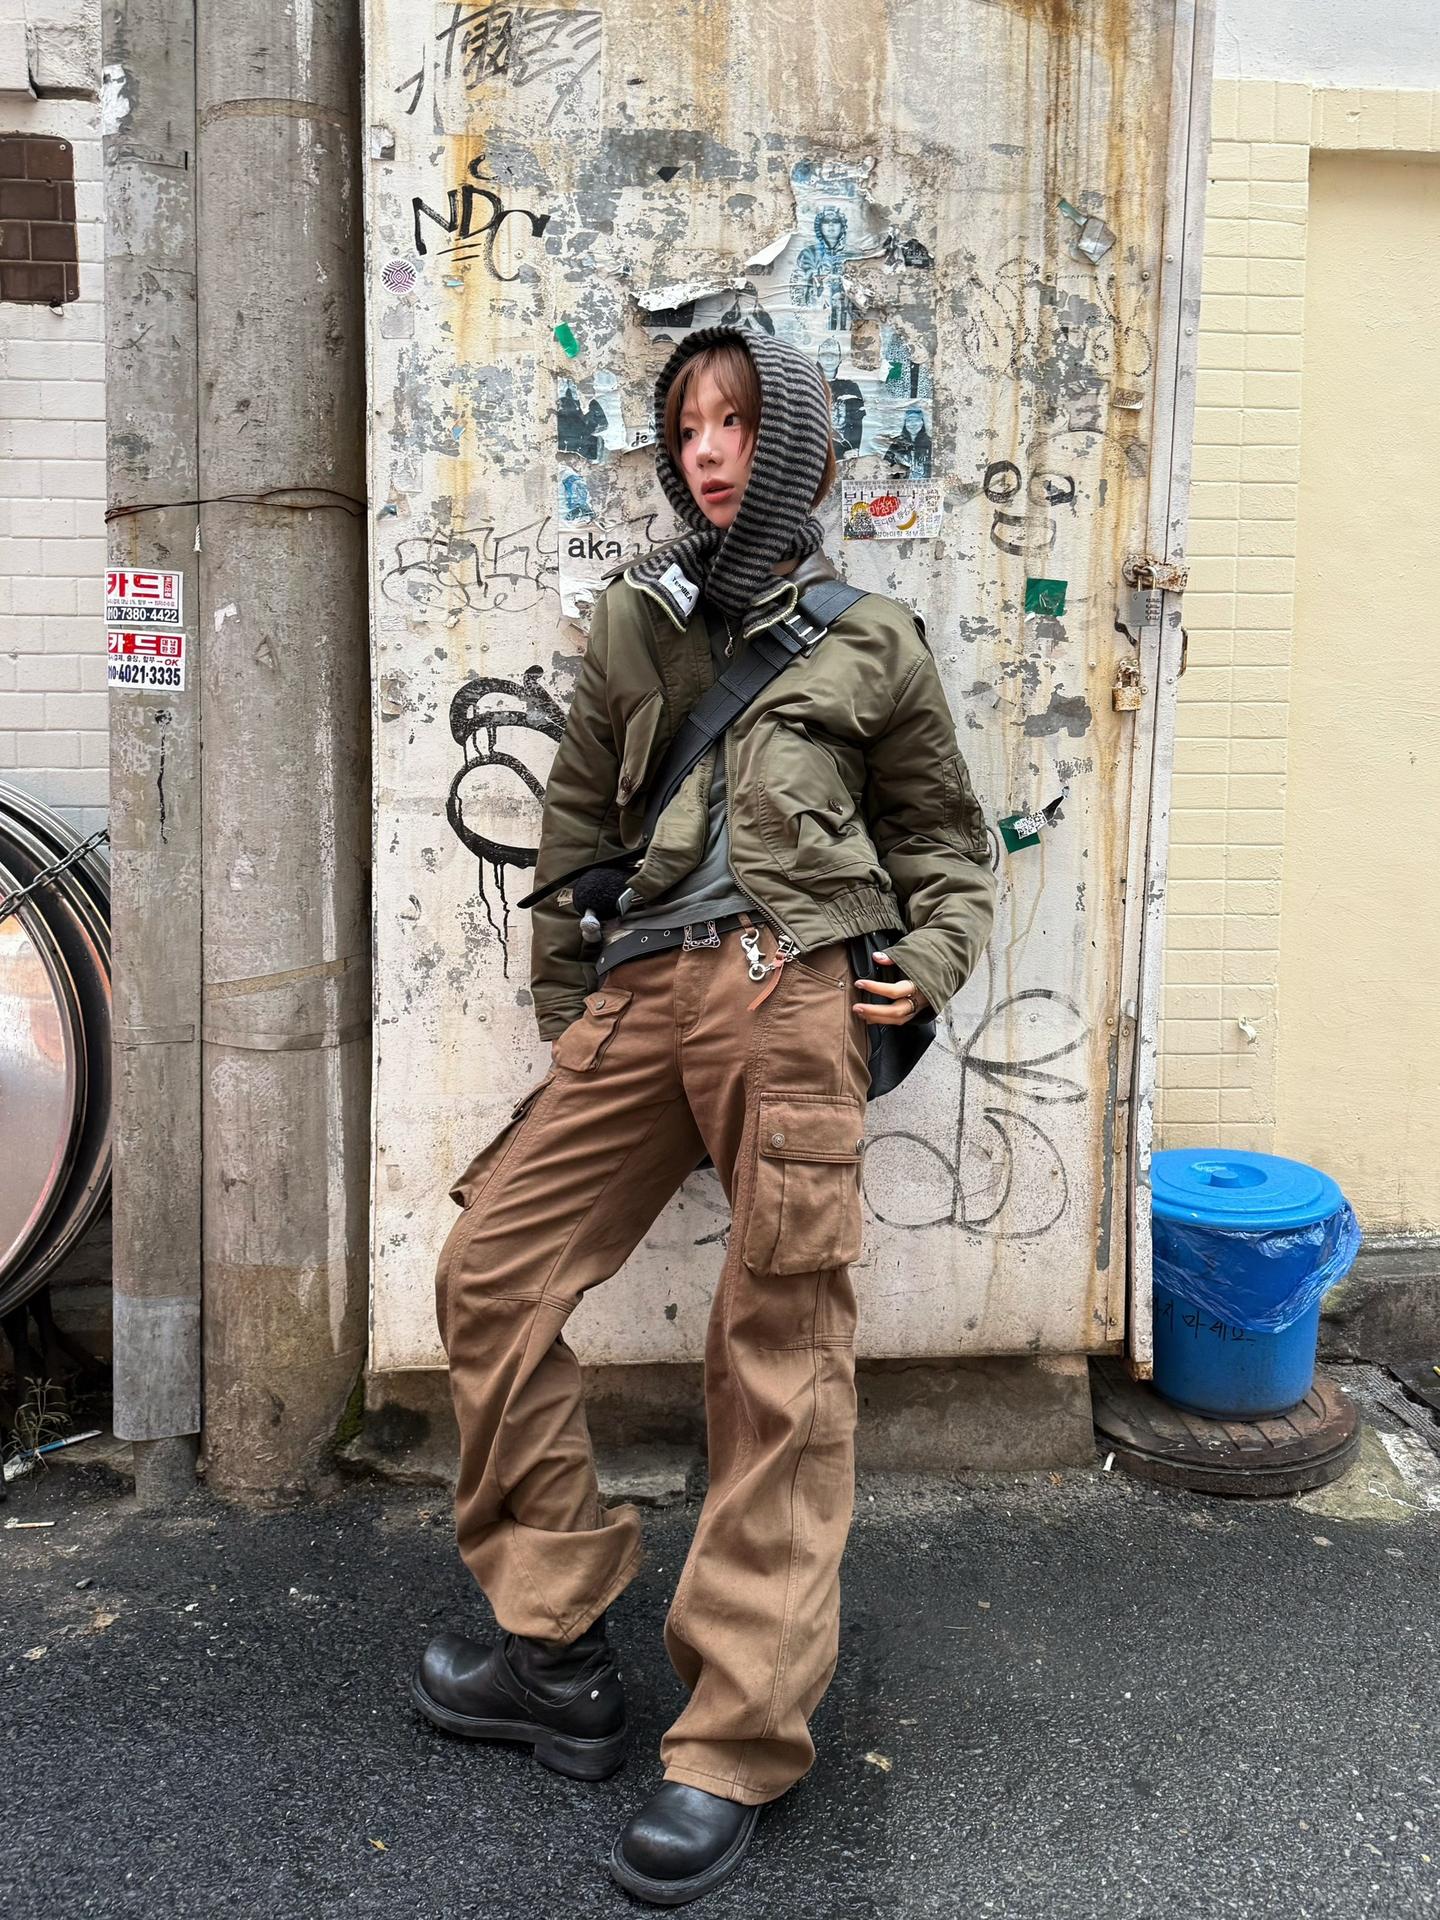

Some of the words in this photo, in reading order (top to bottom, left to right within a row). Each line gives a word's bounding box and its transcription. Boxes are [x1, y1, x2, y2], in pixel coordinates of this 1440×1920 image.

[568, 532, 622, 560] aka
[107, 573, 160, 599] 카드
[108, 633, 157, 654] 카드
